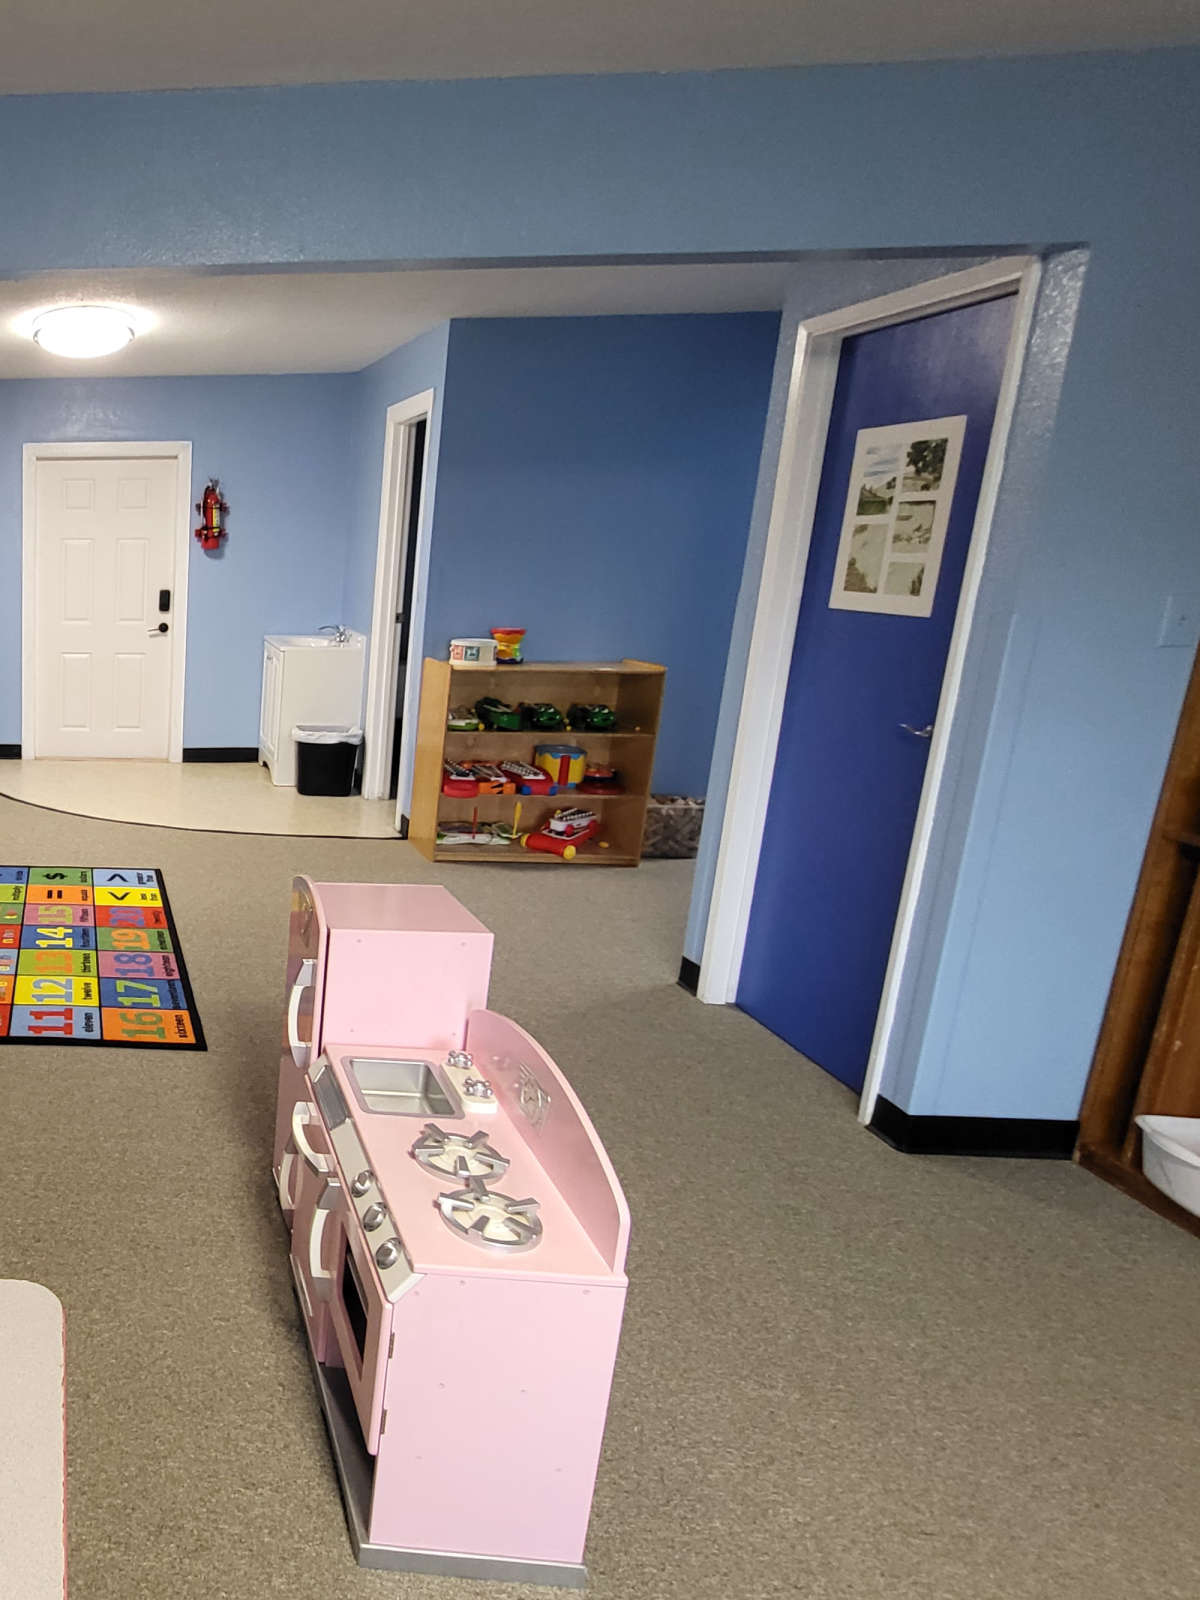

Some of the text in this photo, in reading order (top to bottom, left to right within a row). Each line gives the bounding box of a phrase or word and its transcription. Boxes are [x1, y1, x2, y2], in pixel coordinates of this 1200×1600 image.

[38, 905, 73, 924] 15
[109, 907, 145, 927] 20
[35, 926, 73, 948] 14
[110, 928, 150, 950] 19
[34, 951, 73, 974] 13
[113, 953, 155, 977] 18
[31, 978, 73, 1003] 12
[81, 982, 93, 1000] twelve
[116, 980, 160, 1007] 17
[27, 1008, 73, 1036] 11
[81, 1012, 93, 1033] eleven
[120, 1012, 167, 1039] 16
[174, 1014, 188, 1038] sixteen
